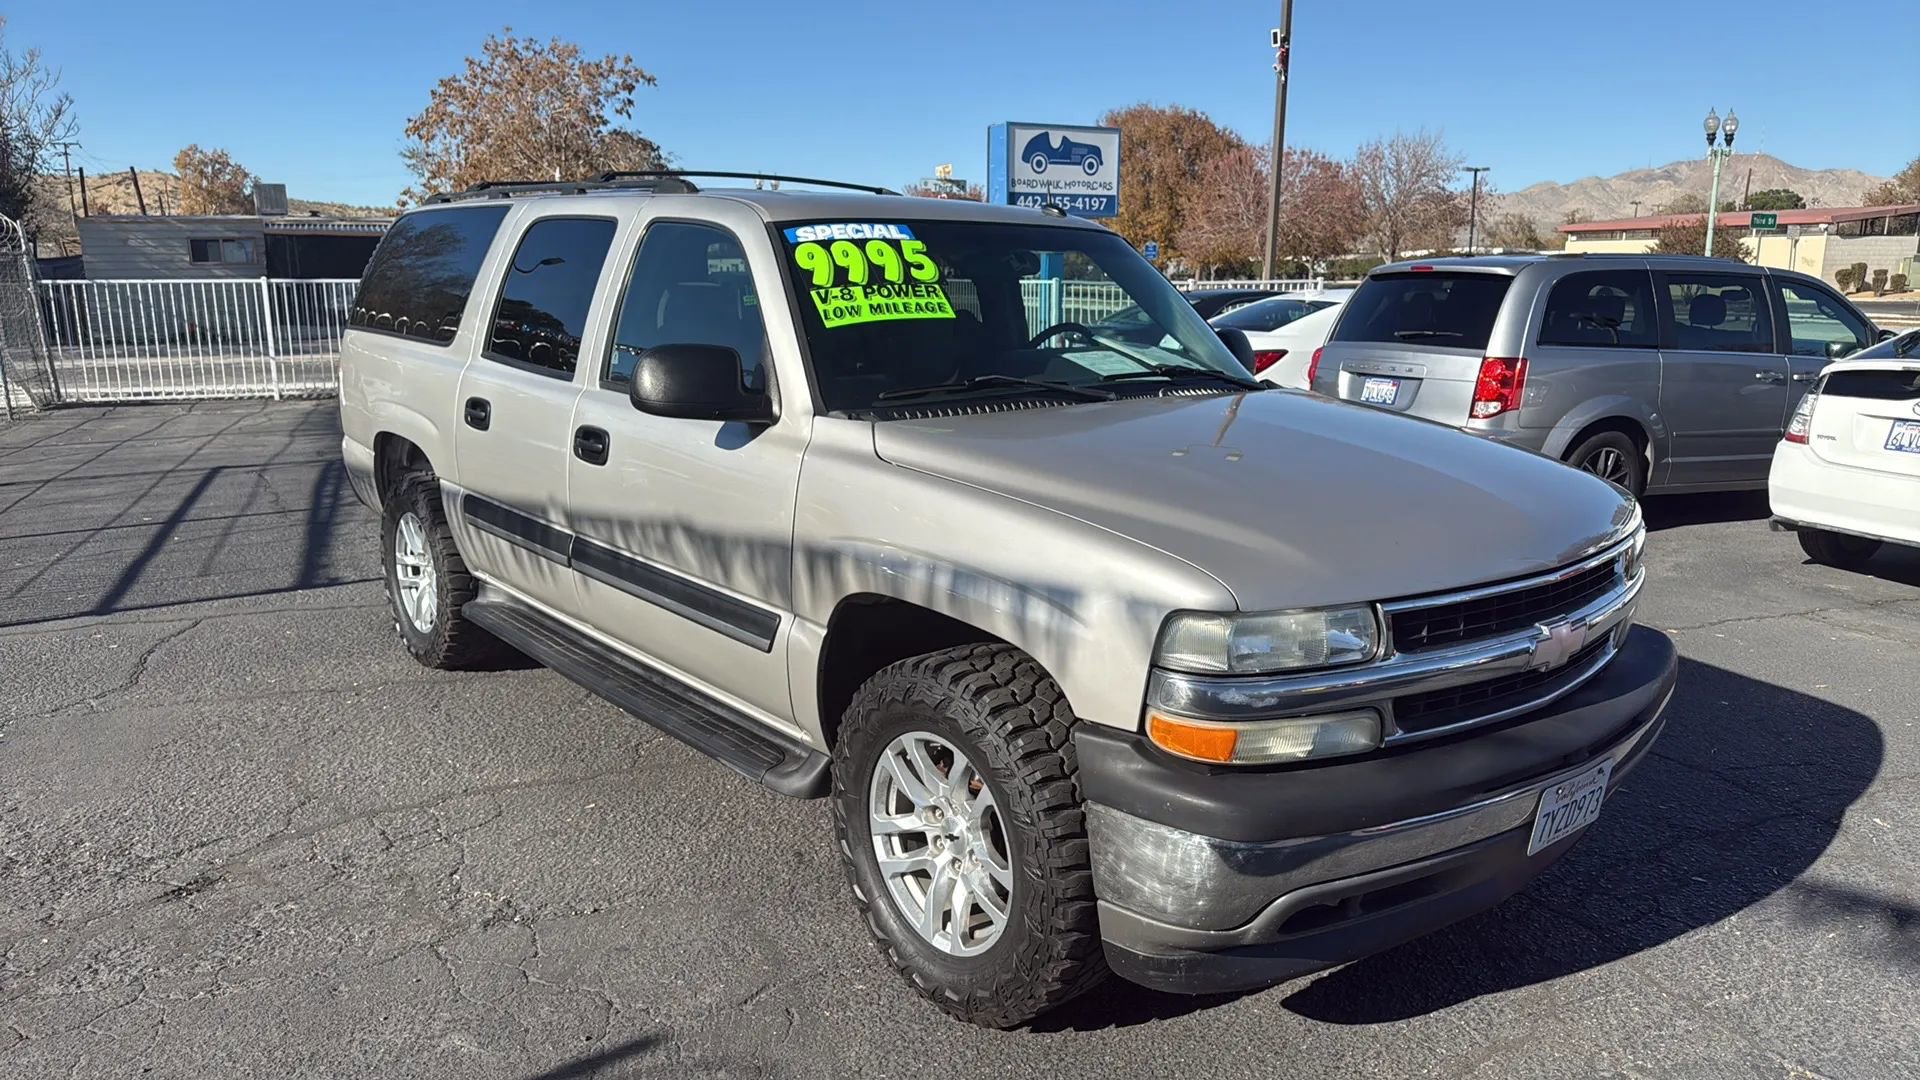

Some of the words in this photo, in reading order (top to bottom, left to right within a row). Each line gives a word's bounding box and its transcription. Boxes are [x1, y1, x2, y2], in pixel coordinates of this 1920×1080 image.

[1063, 181, 1113, 192] MOTORCARS
[795, 224, 910, 242] SPECIAL
[795, 239, 940, 288] 9995
[815, 286, 856, 305] V-8
[864, 284, 942, 300] POWER
[823, 304, 862, 321] LOW
[869, 301, 950, 315] MILEAGE
[1539, 785, 1603, 843] 7YZD973
